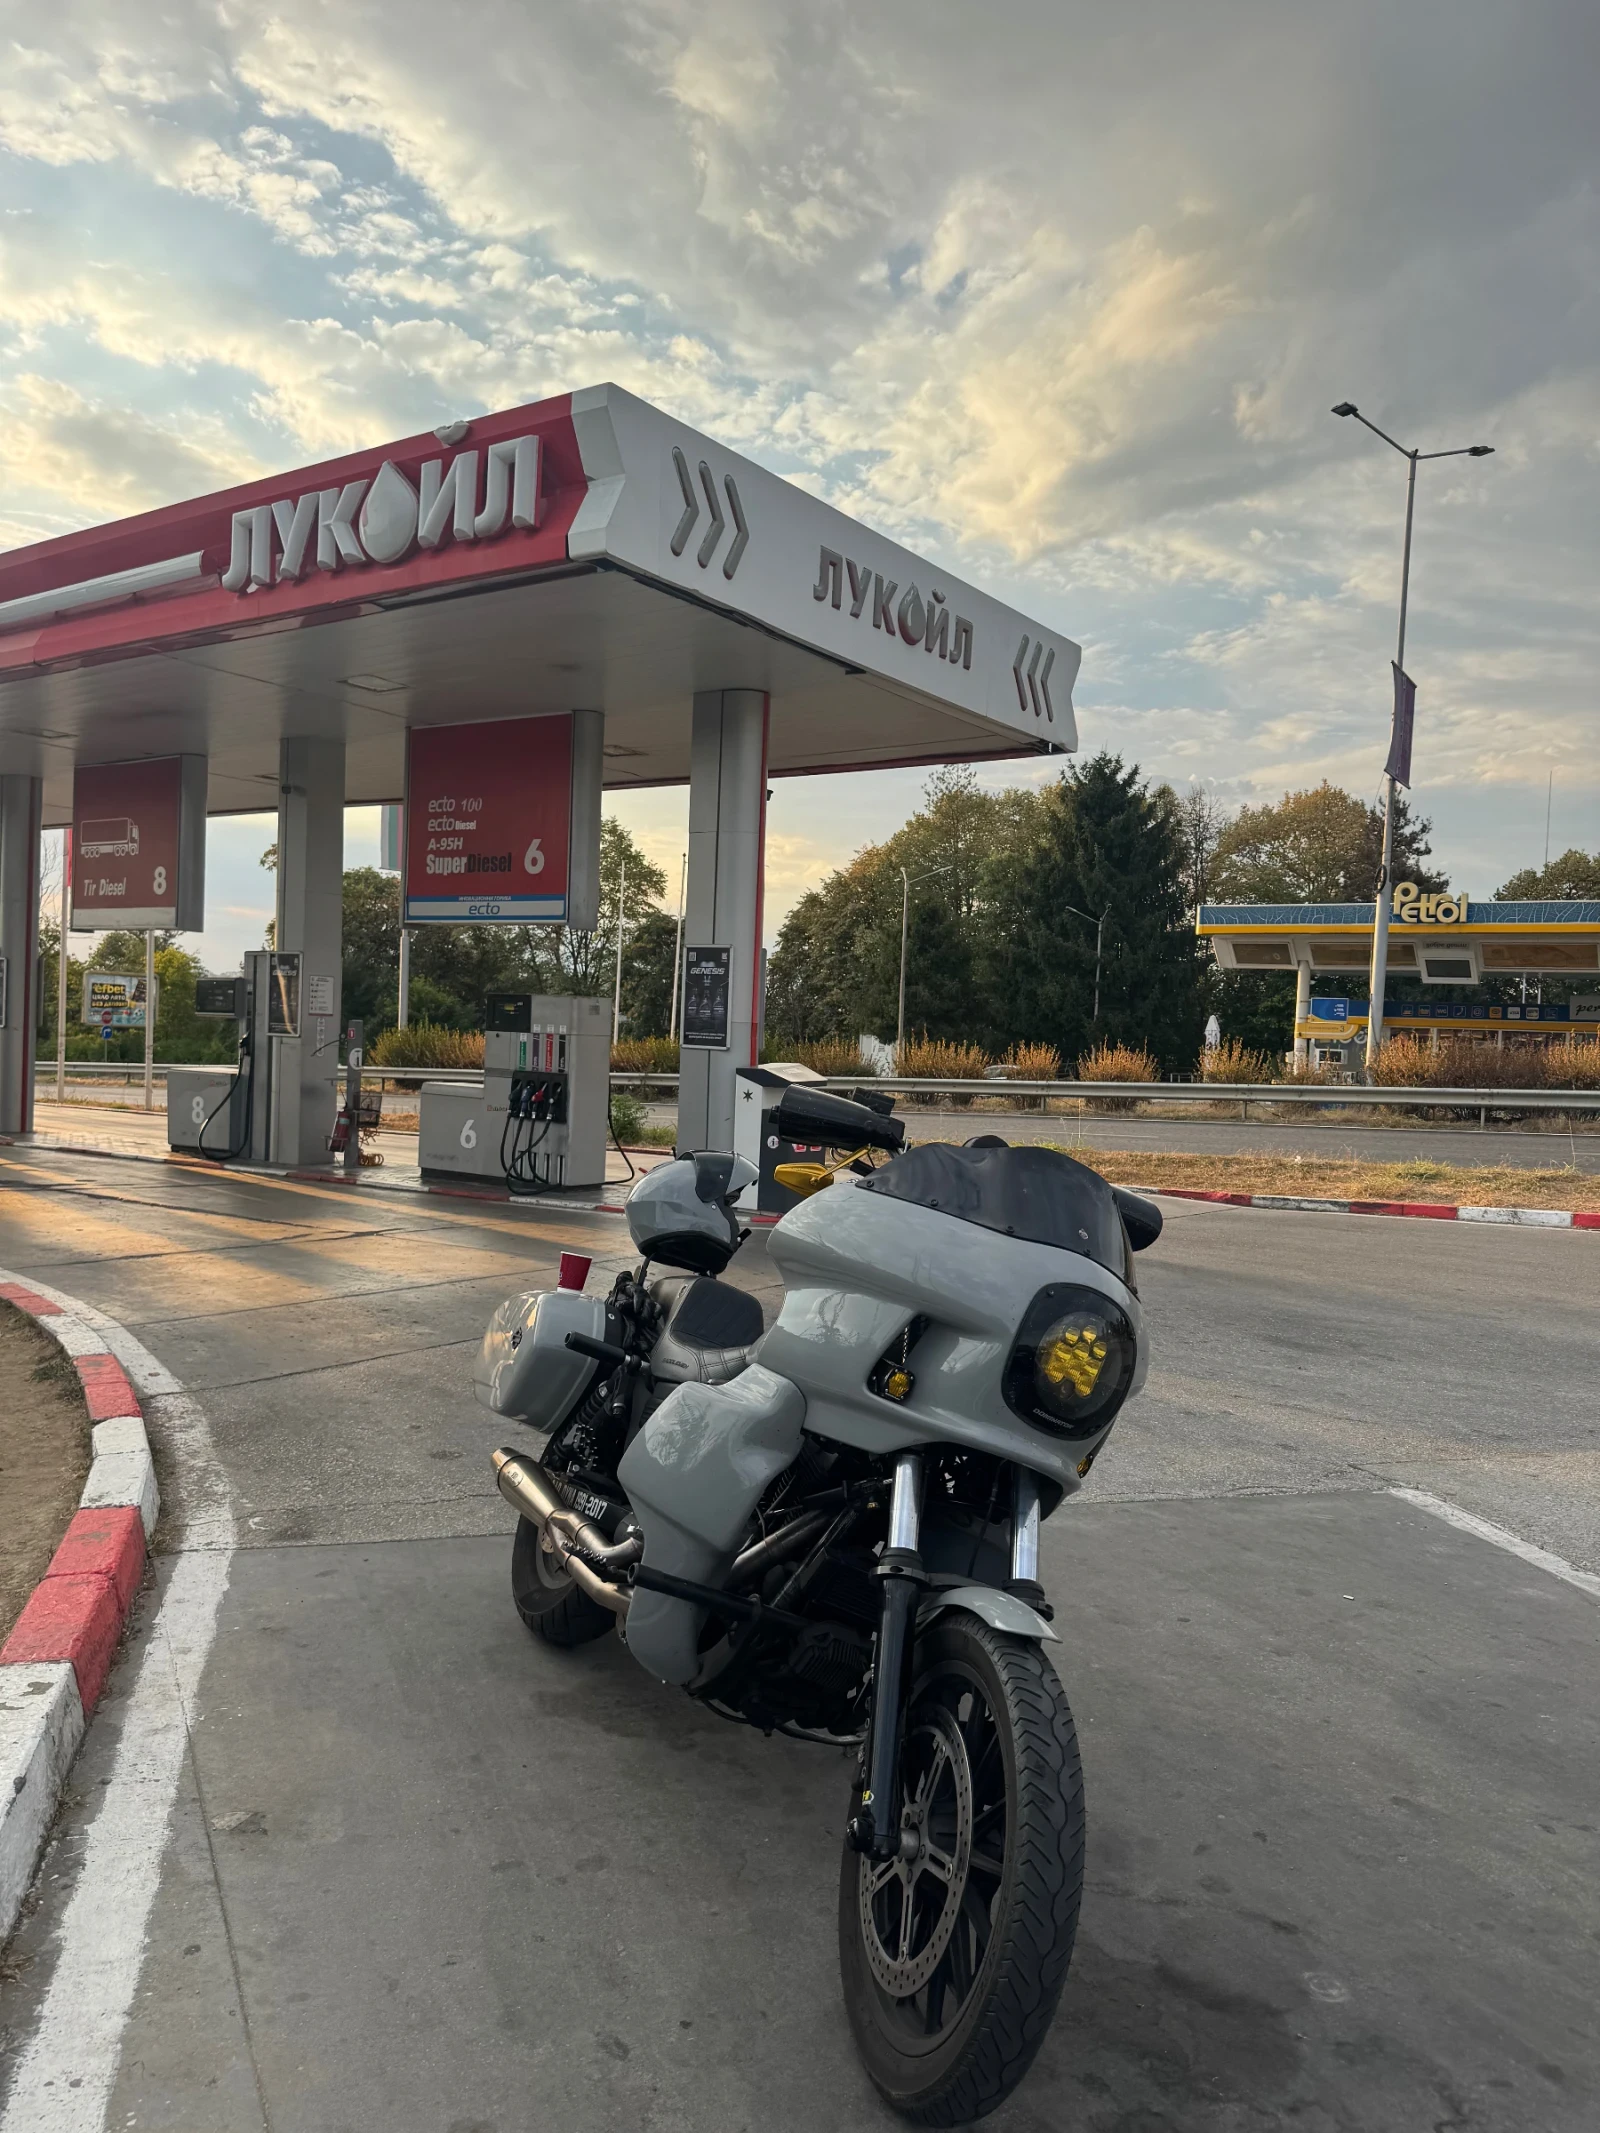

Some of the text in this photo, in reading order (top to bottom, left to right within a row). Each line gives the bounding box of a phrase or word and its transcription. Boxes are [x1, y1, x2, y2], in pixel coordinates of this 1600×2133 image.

[428, 796, 482, 812] ecto 100
[524, 838, 545, 875] 6
[84, 877, 127, 896] Tir Diesel
[153, 866, 167, 895] 8
[468, 902, 501, 915] ecto
[1393, 881, 1469, 924] Petrol
[690, 967, 726, 975] GENESIS
[93, 984, 126, 994] efbet
[191, 1095, 205, 1124] 8
[460, 1119, 477, 1149] 6
[1032, 1407, 1075, 1430] DOMINATOR
